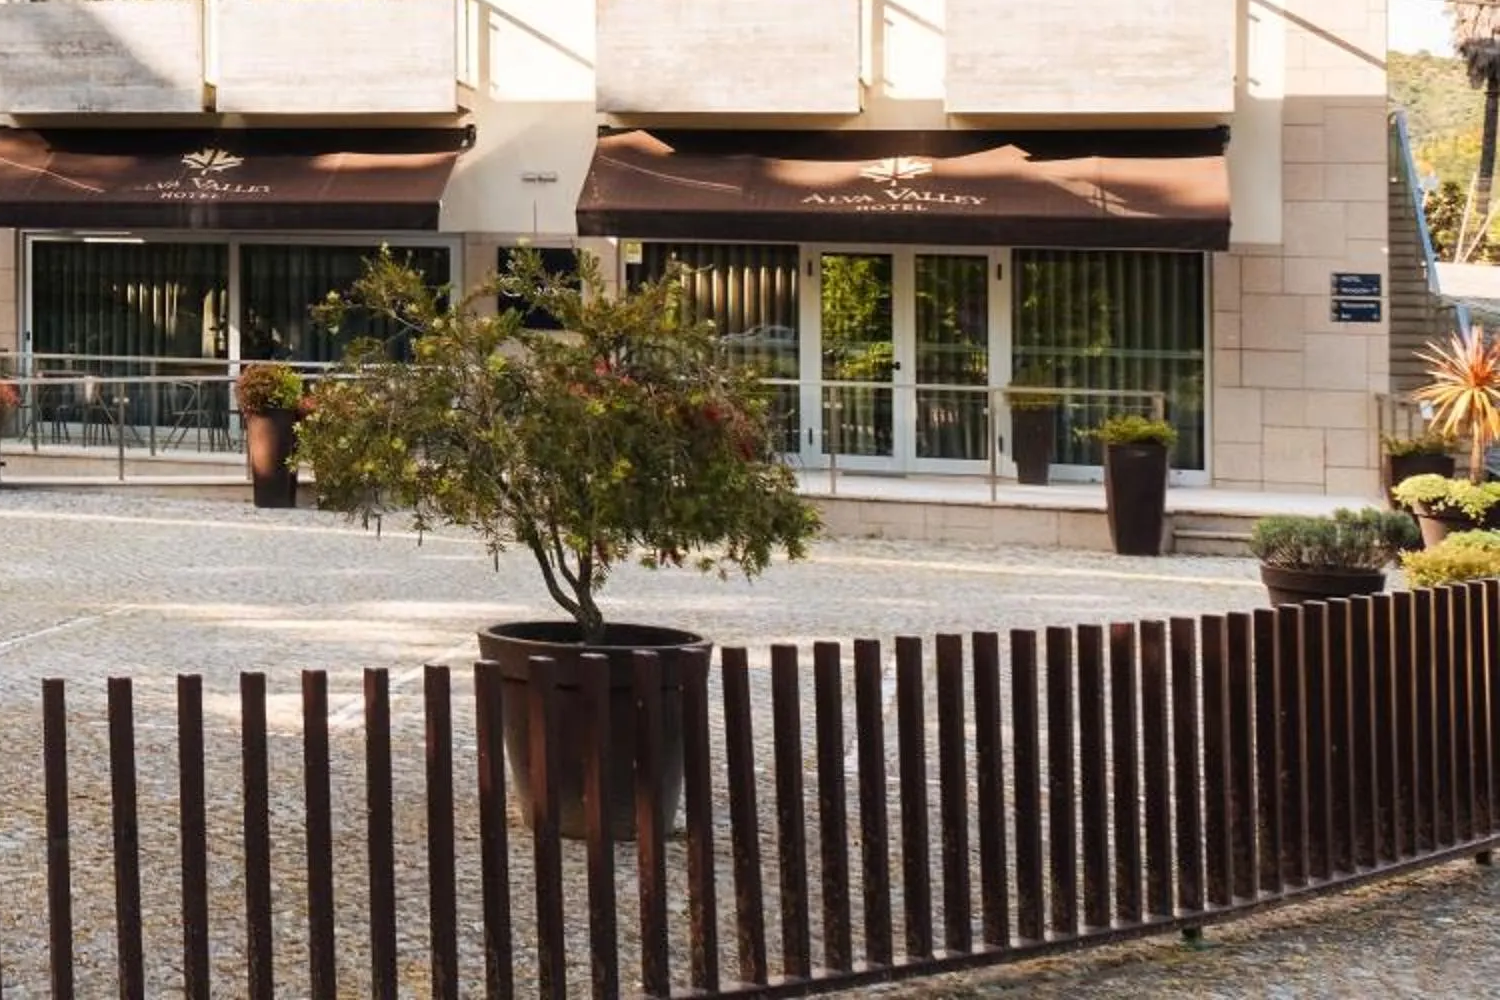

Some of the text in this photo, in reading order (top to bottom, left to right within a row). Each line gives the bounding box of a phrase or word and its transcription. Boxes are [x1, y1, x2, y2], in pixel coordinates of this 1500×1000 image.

[802, 187, 987, 205] ALVA VALLEY
[855, 203, 928, 211] HOTEL
